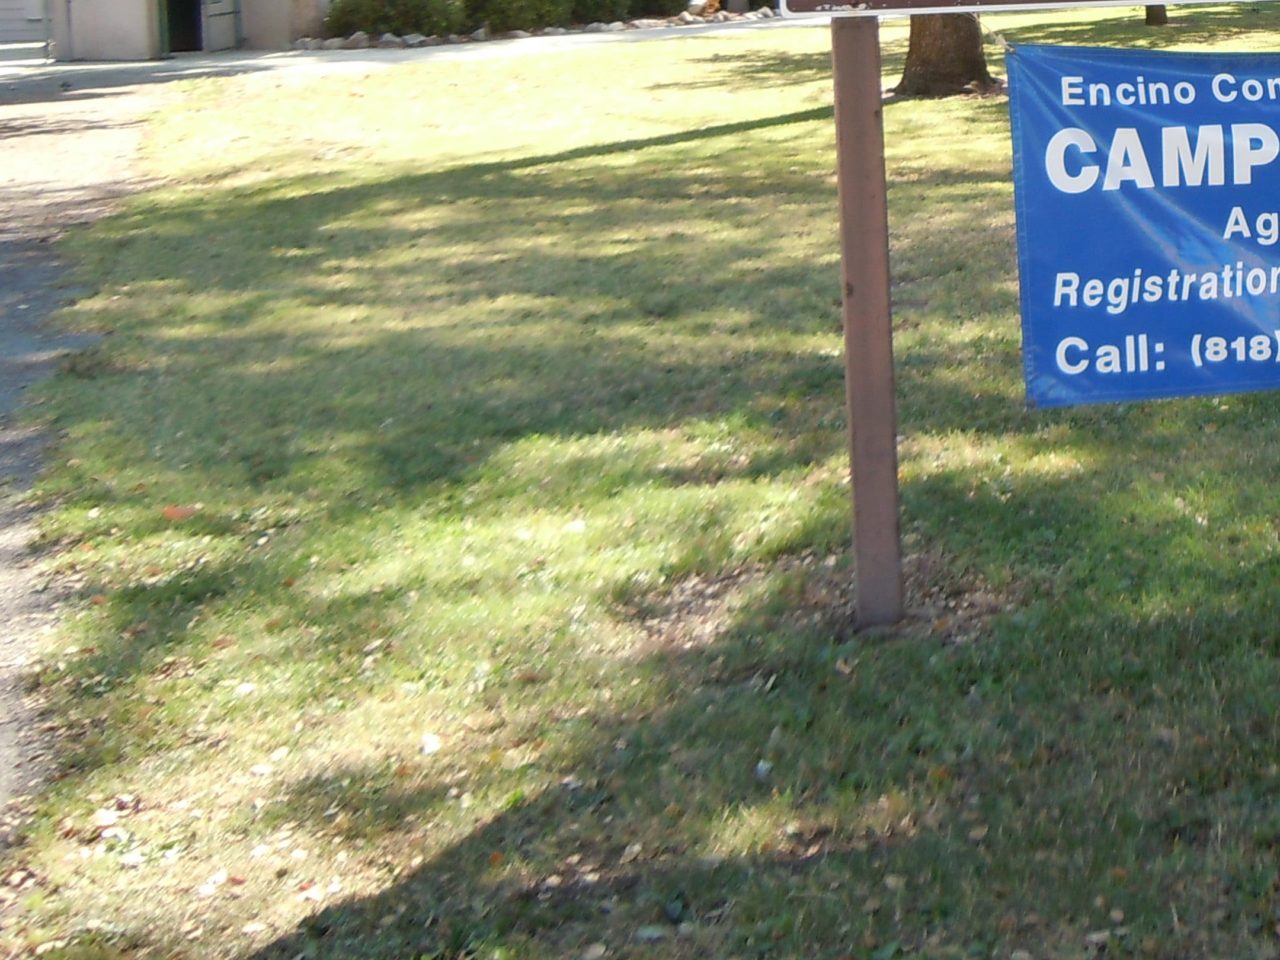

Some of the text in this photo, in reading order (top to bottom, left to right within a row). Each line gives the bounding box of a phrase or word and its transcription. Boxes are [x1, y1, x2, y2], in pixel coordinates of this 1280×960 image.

[1061, 77, 1196, 106] Encino
[1045, 123, 1280, 194] CAMP
[1055, 335, 1165, 375] Call:
